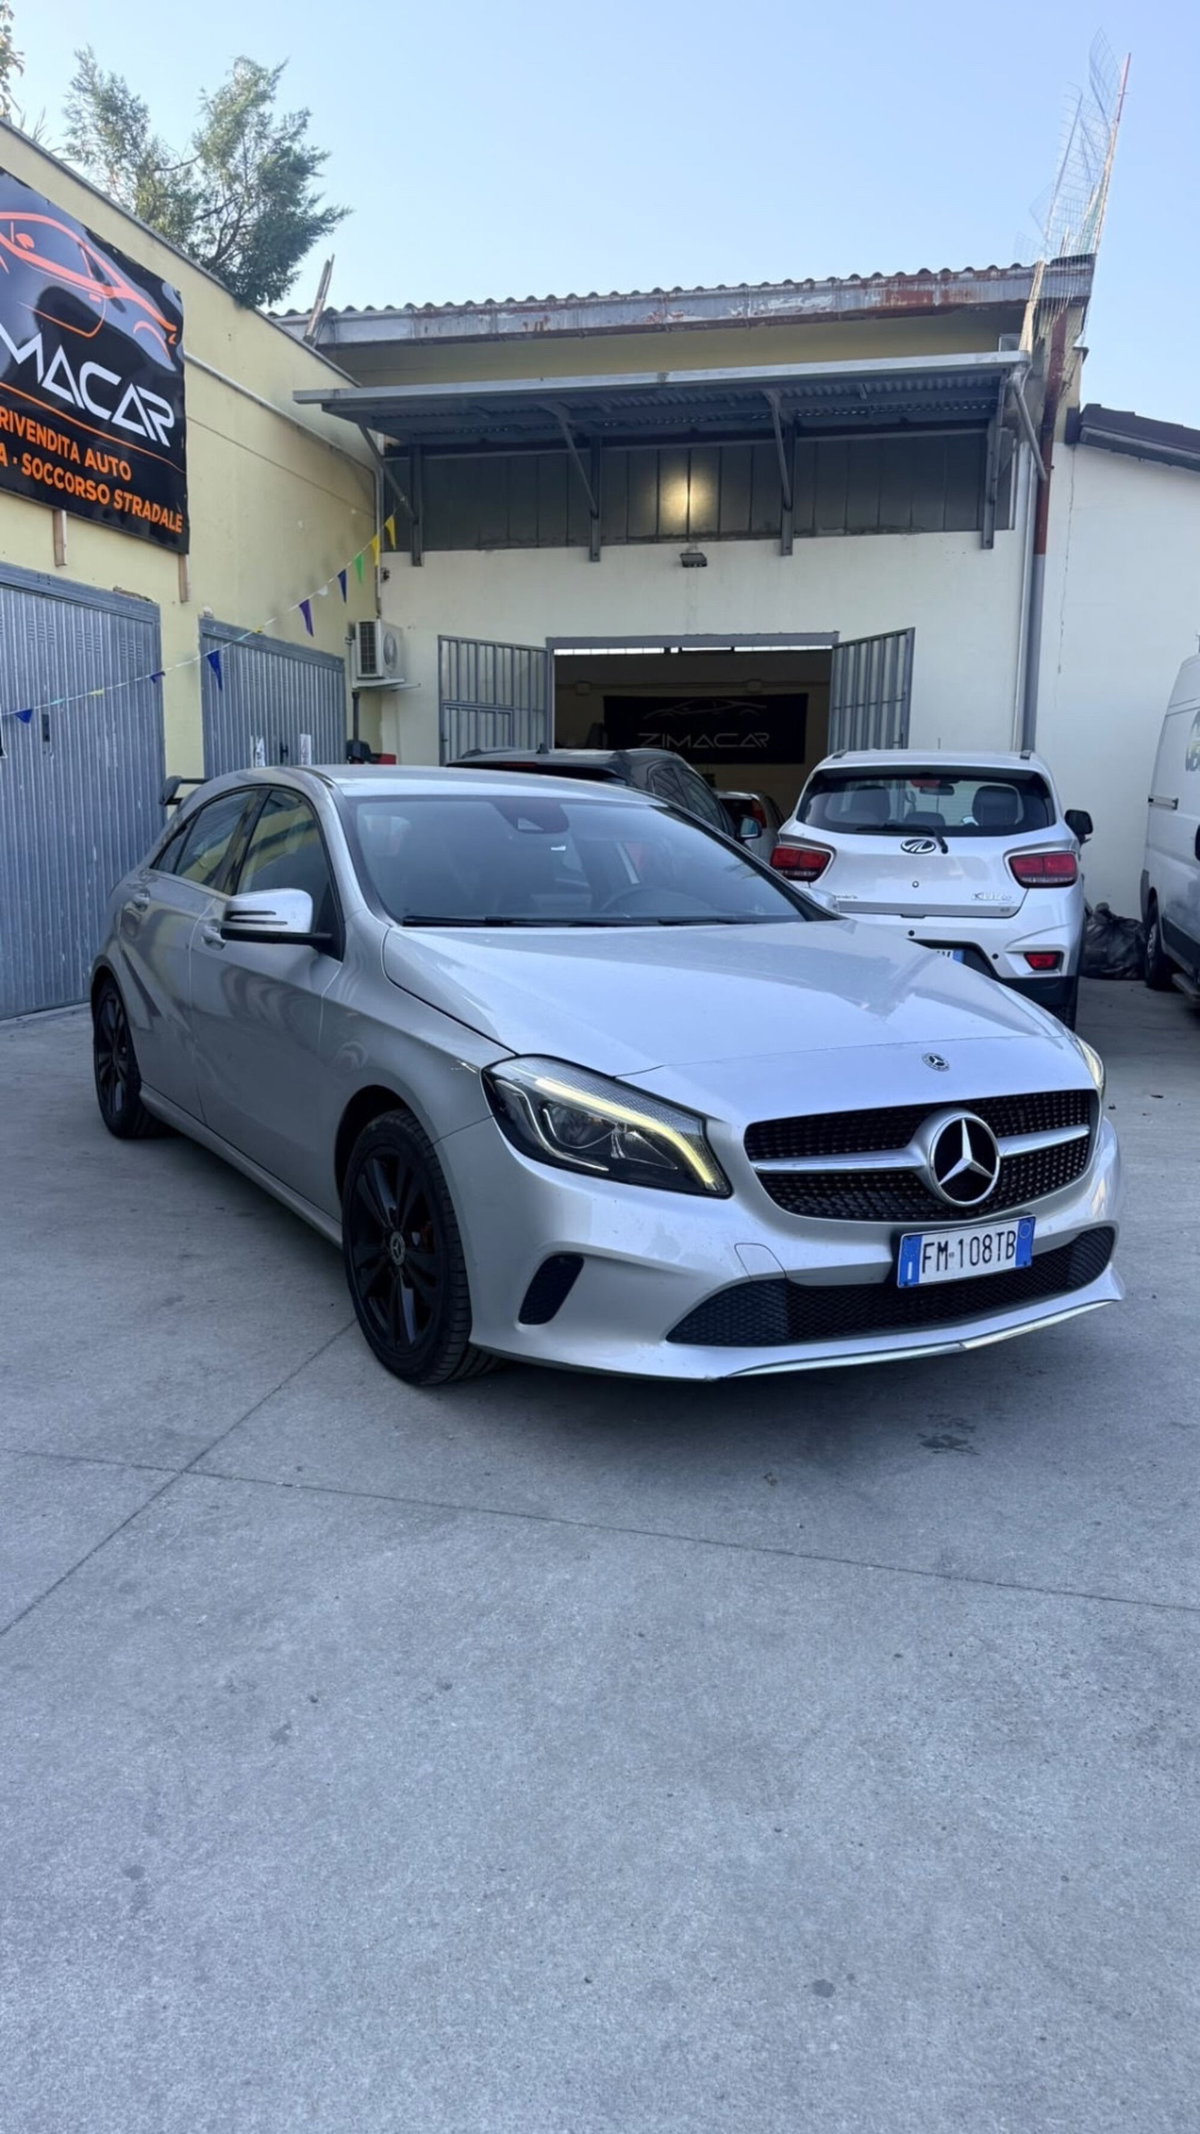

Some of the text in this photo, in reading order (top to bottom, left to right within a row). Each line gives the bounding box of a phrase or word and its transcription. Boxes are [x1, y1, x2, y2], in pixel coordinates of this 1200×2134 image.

[0, 405, 132, 481] RIVENDITA AUTO
[21, 452, 110, 505] SOCCORSO
[113, 488, 183, 533] STRADALE
[637, 732, 770, 749] ZIMACAR
